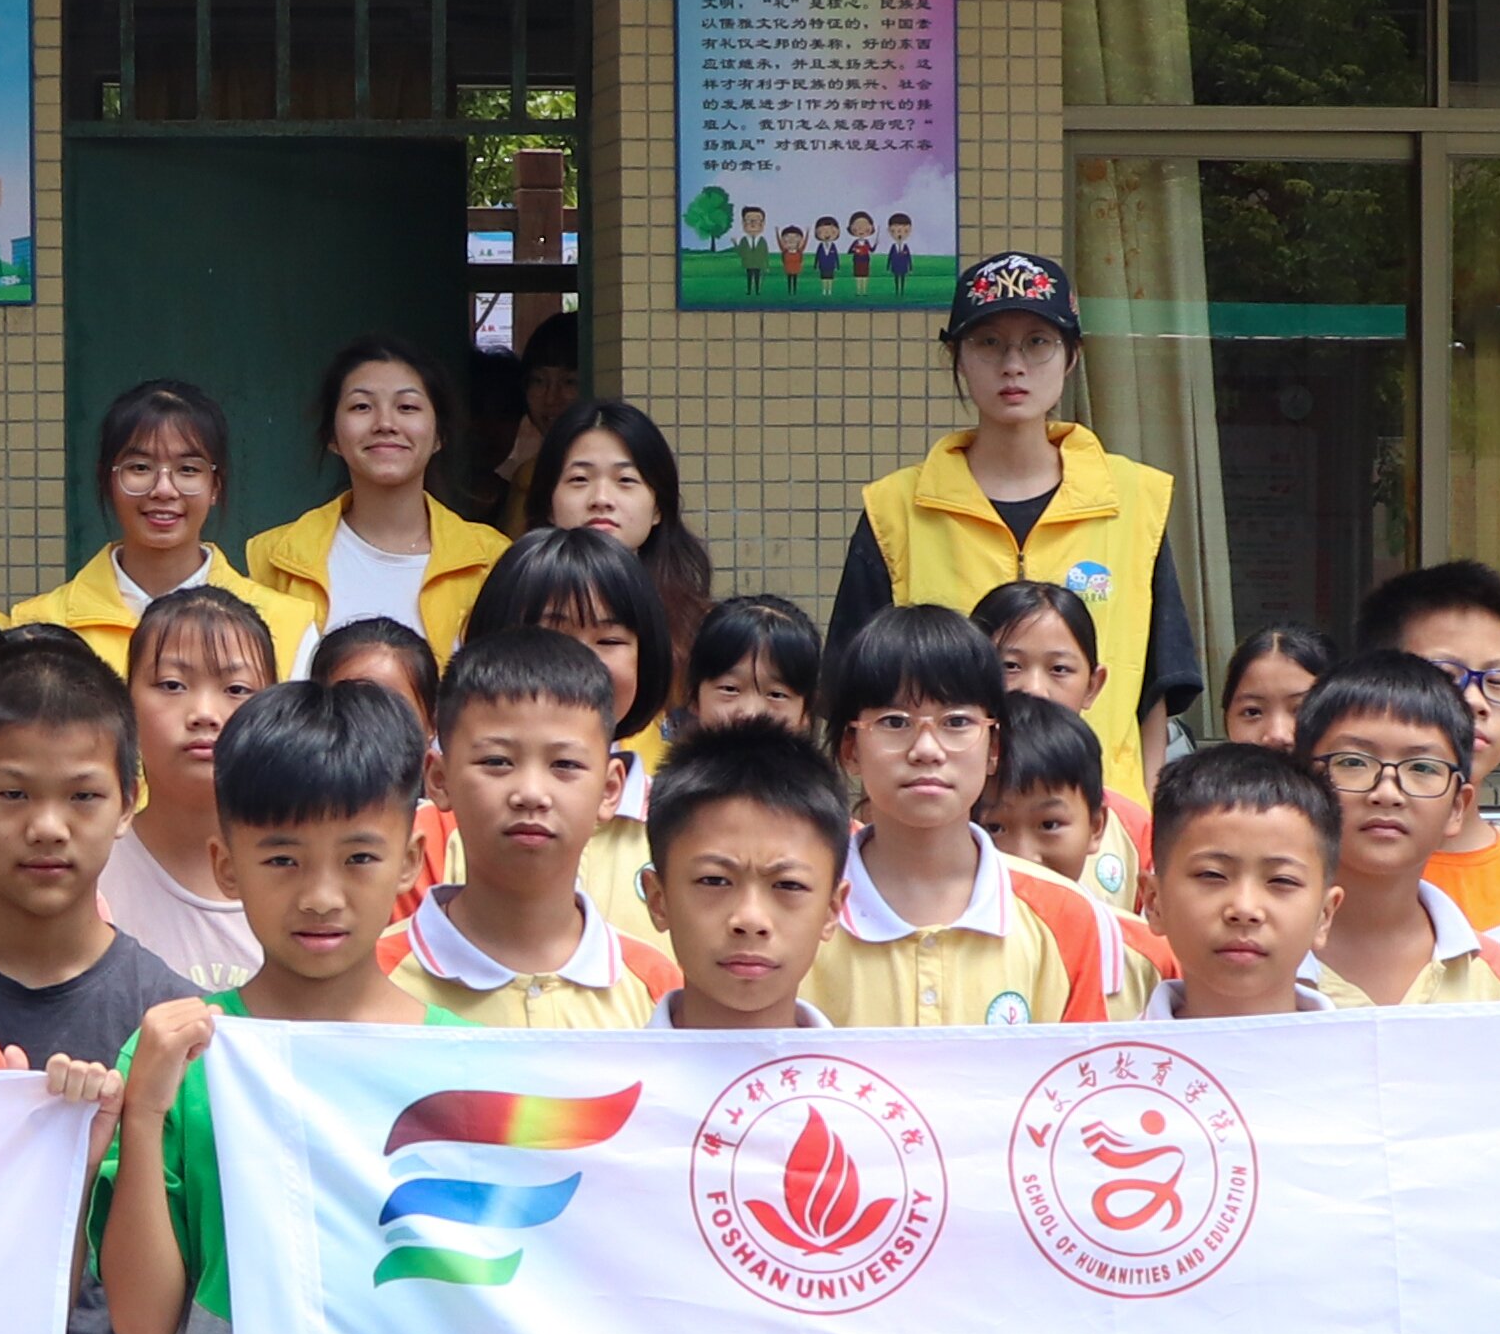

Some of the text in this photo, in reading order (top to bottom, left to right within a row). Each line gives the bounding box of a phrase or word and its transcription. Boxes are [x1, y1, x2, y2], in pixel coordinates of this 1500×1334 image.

[703, 159, 782, 171] 辞的责任。
[706, 1188, 934, 1301] FOSHAN UNIVERSITY
[1022, 1164, 1249, 1286] SCHOOL OF HUMANITIES AND EDUCATION
